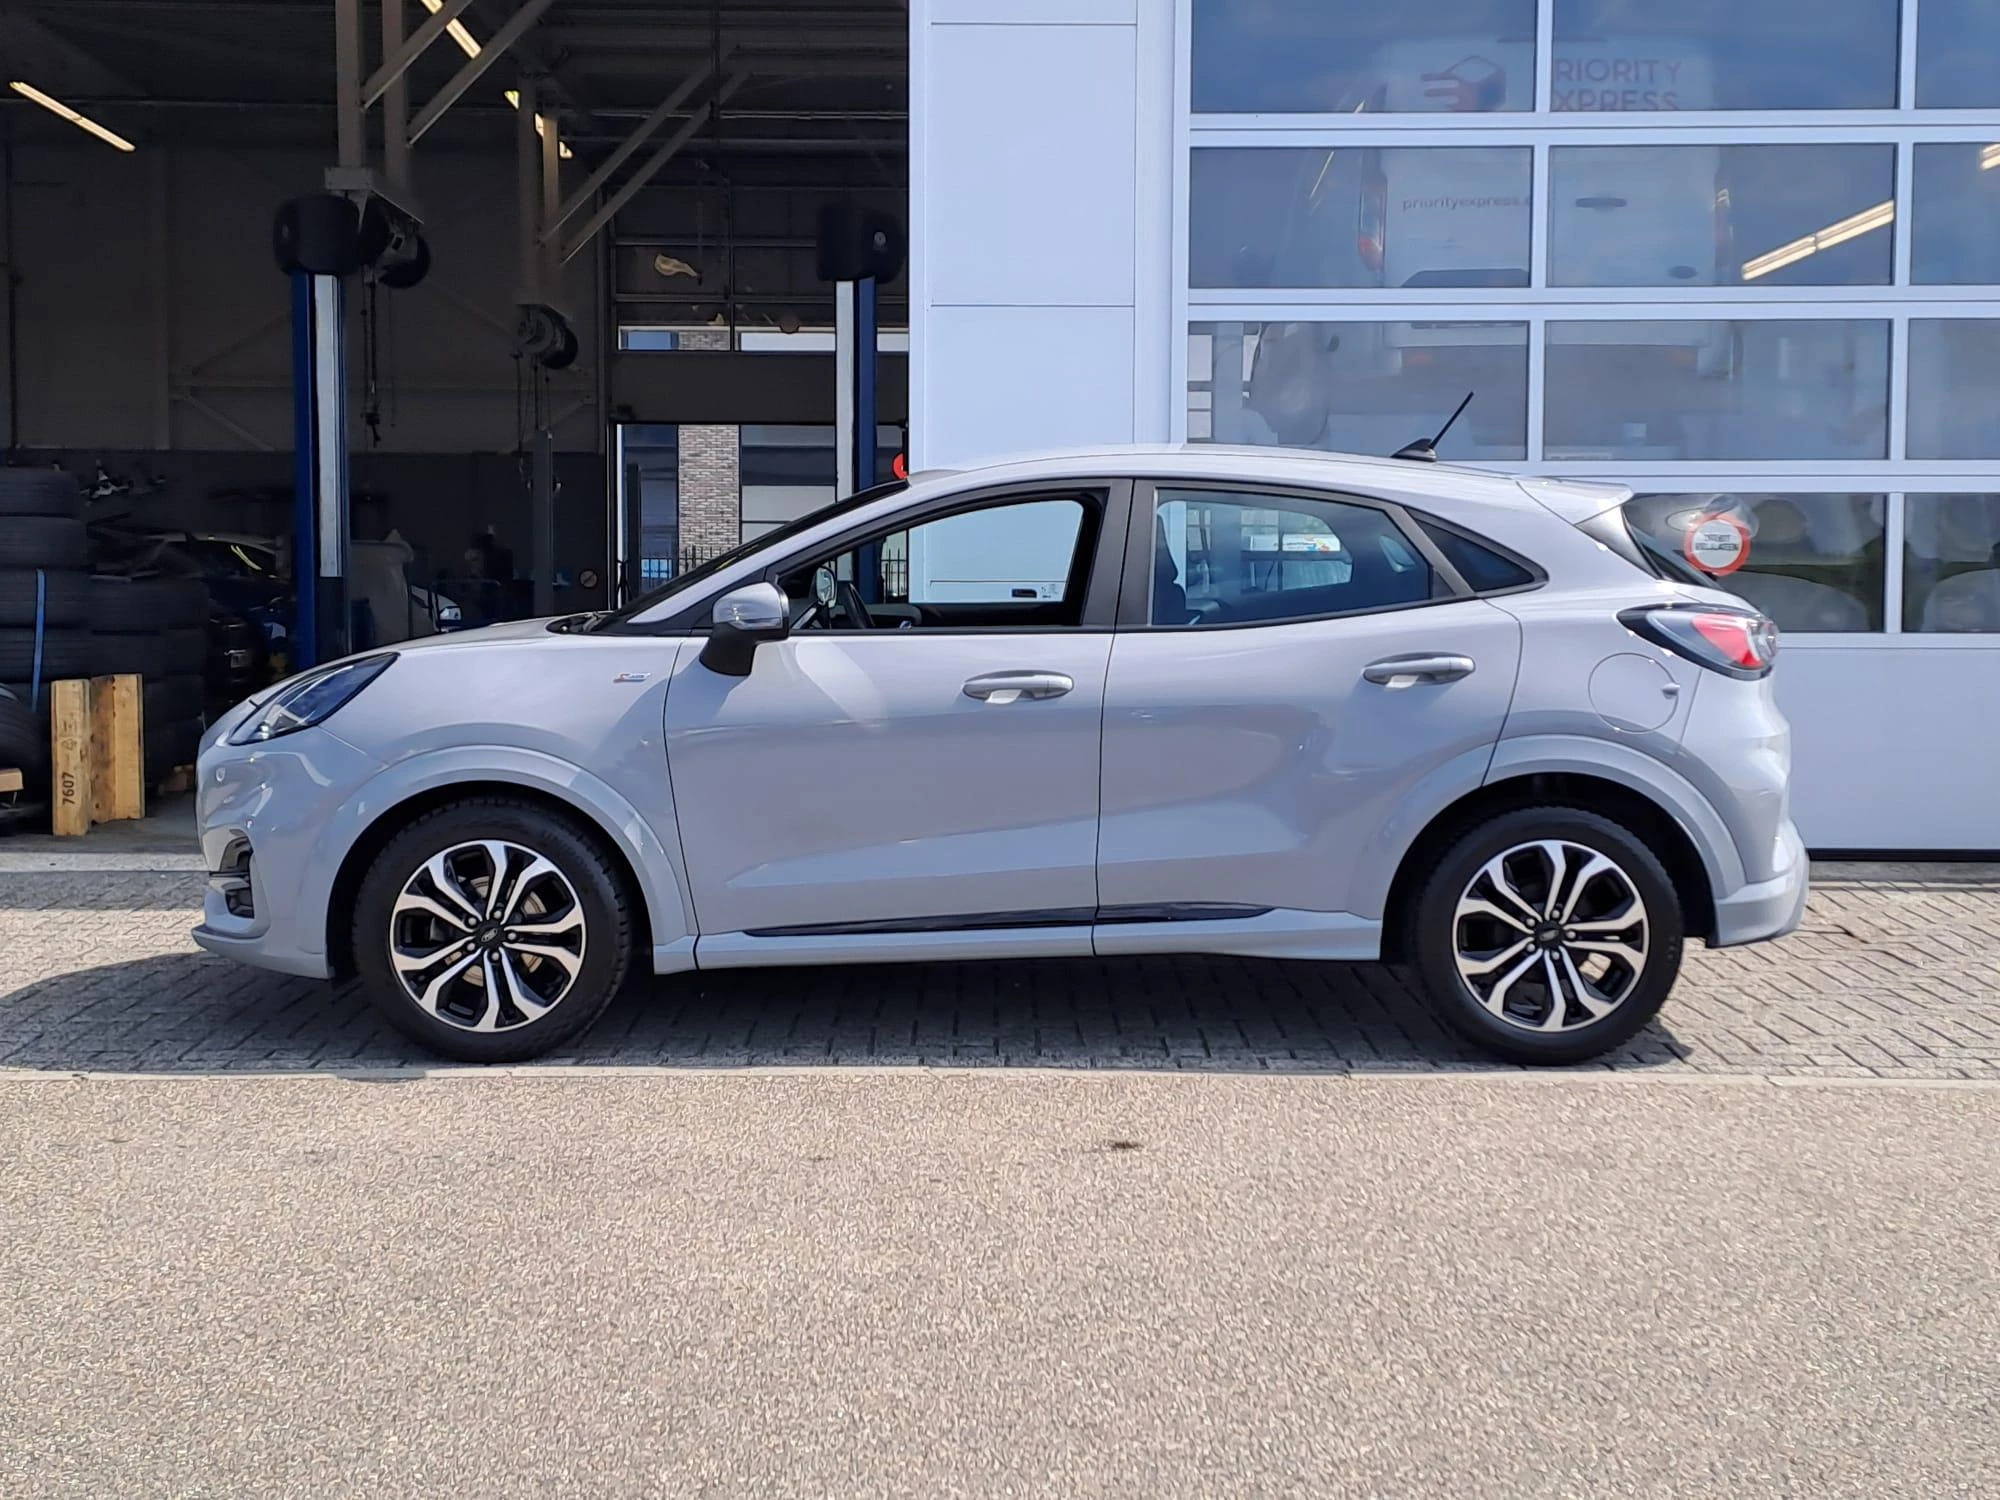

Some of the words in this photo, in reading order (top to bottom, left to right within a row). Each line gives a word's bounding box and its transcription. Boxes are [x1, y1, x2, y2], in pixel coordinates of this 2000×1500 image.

[1555, 58, 1681, 84] RIORITY
[1553, 88, 1679, 110] XPRESS
[62, 771, 75, 805] 7607
